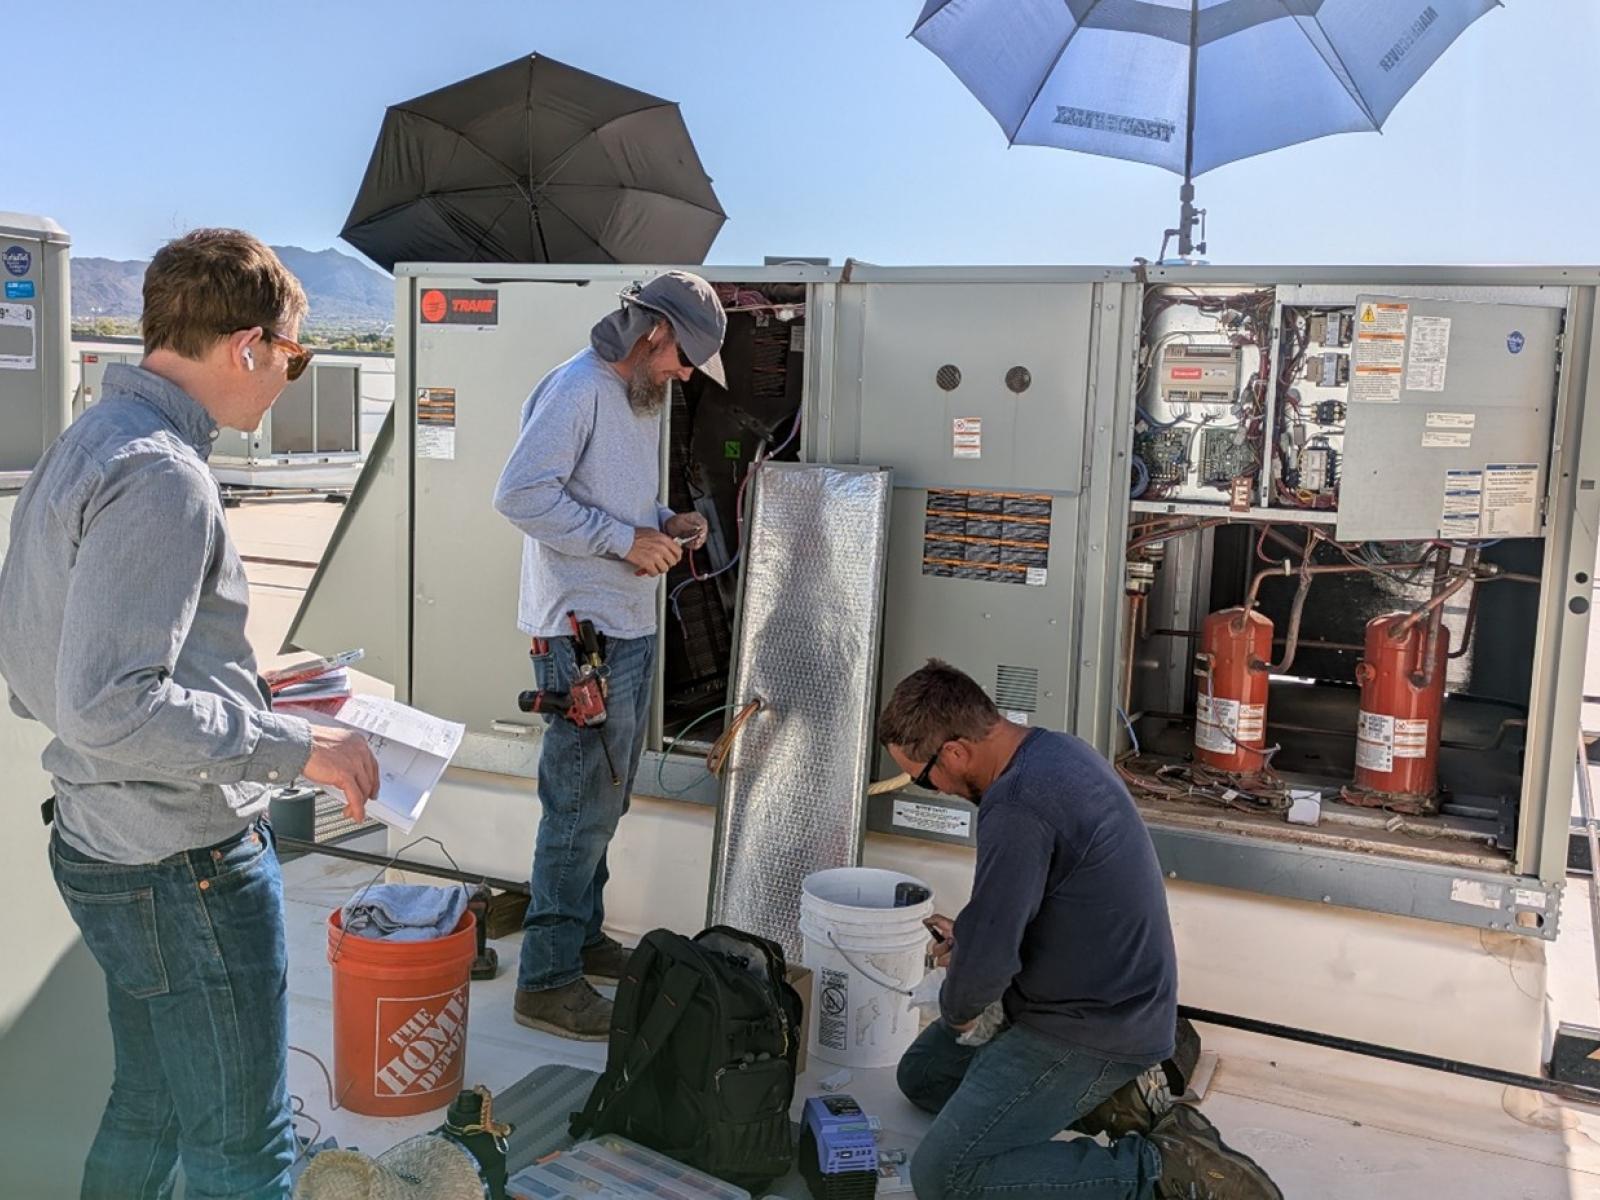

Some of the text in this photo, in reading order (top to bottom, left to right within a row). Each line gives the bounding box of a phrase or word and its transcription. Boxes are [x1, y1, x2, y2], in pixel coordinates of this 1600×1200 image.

[451, 298, 497, 313] TRANE
[377, 987, 466, 1095] HOME
[387, 1008, 434, 1048] THE
